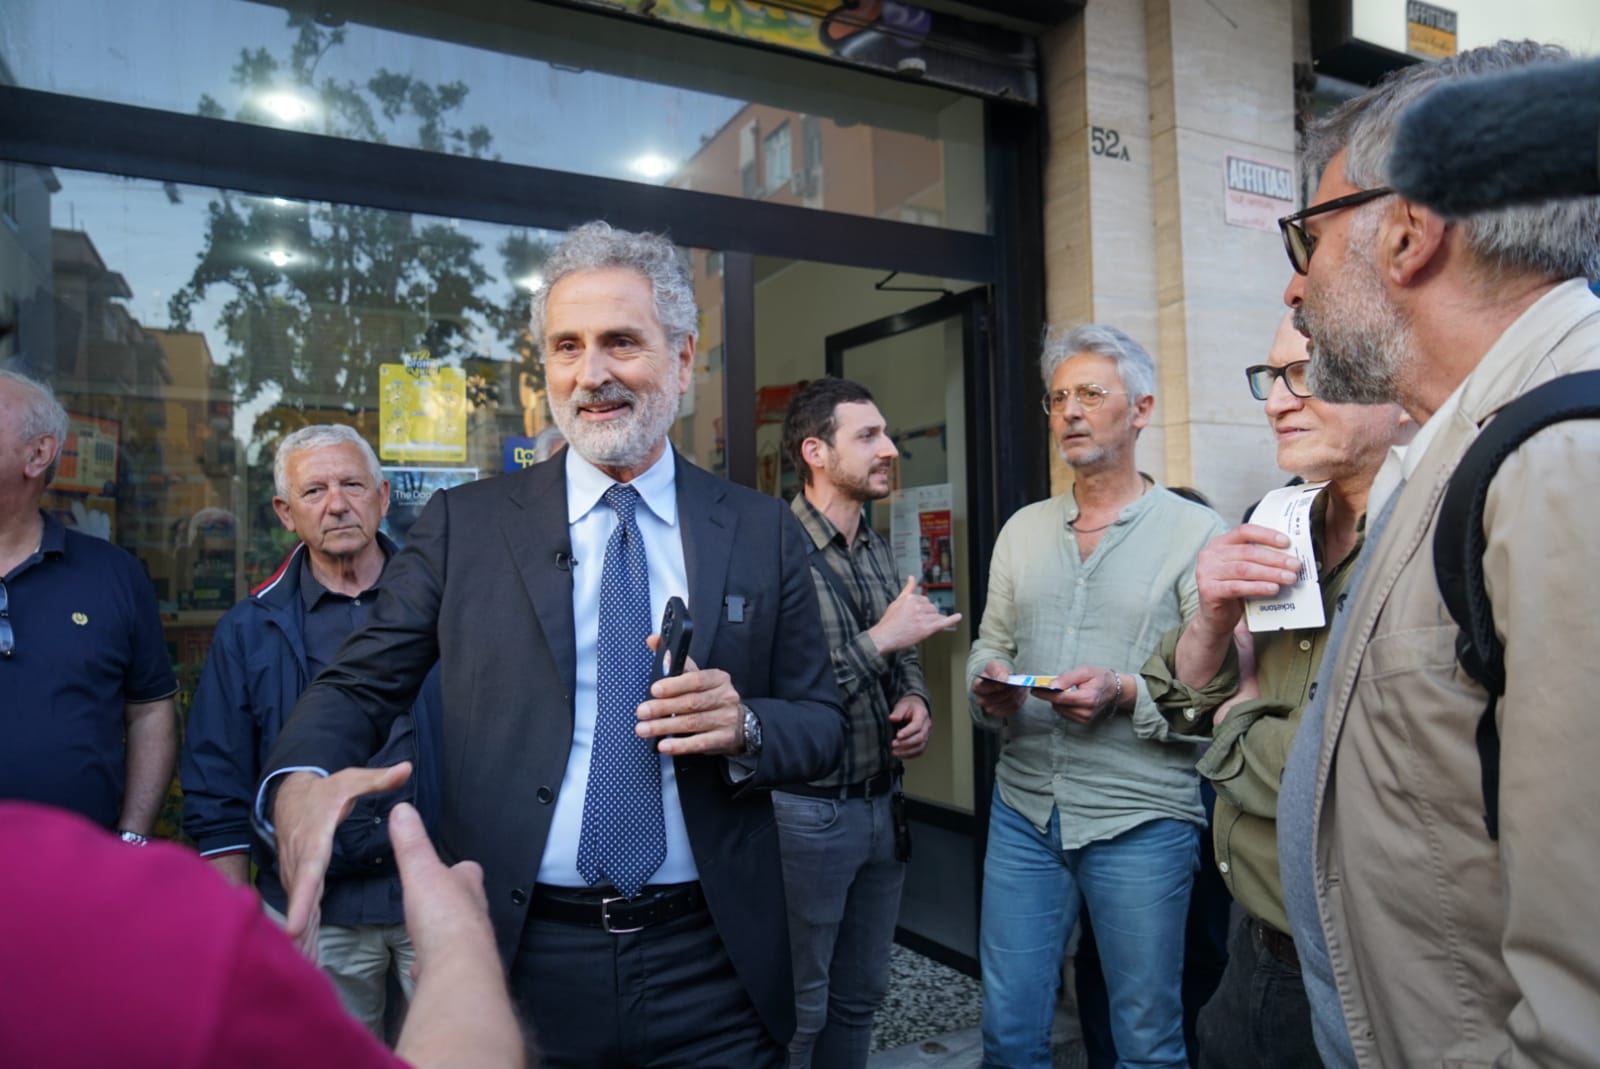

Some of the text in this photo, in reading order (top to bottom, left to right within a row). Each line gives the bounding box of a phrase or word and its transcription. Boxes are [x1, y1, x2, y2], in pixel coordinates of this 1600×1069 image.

[1229, 158, 1293, 201] AFFITTASI
[395, 490, 411, 500] The
[1259, 602, 1296, 612] ticketone
